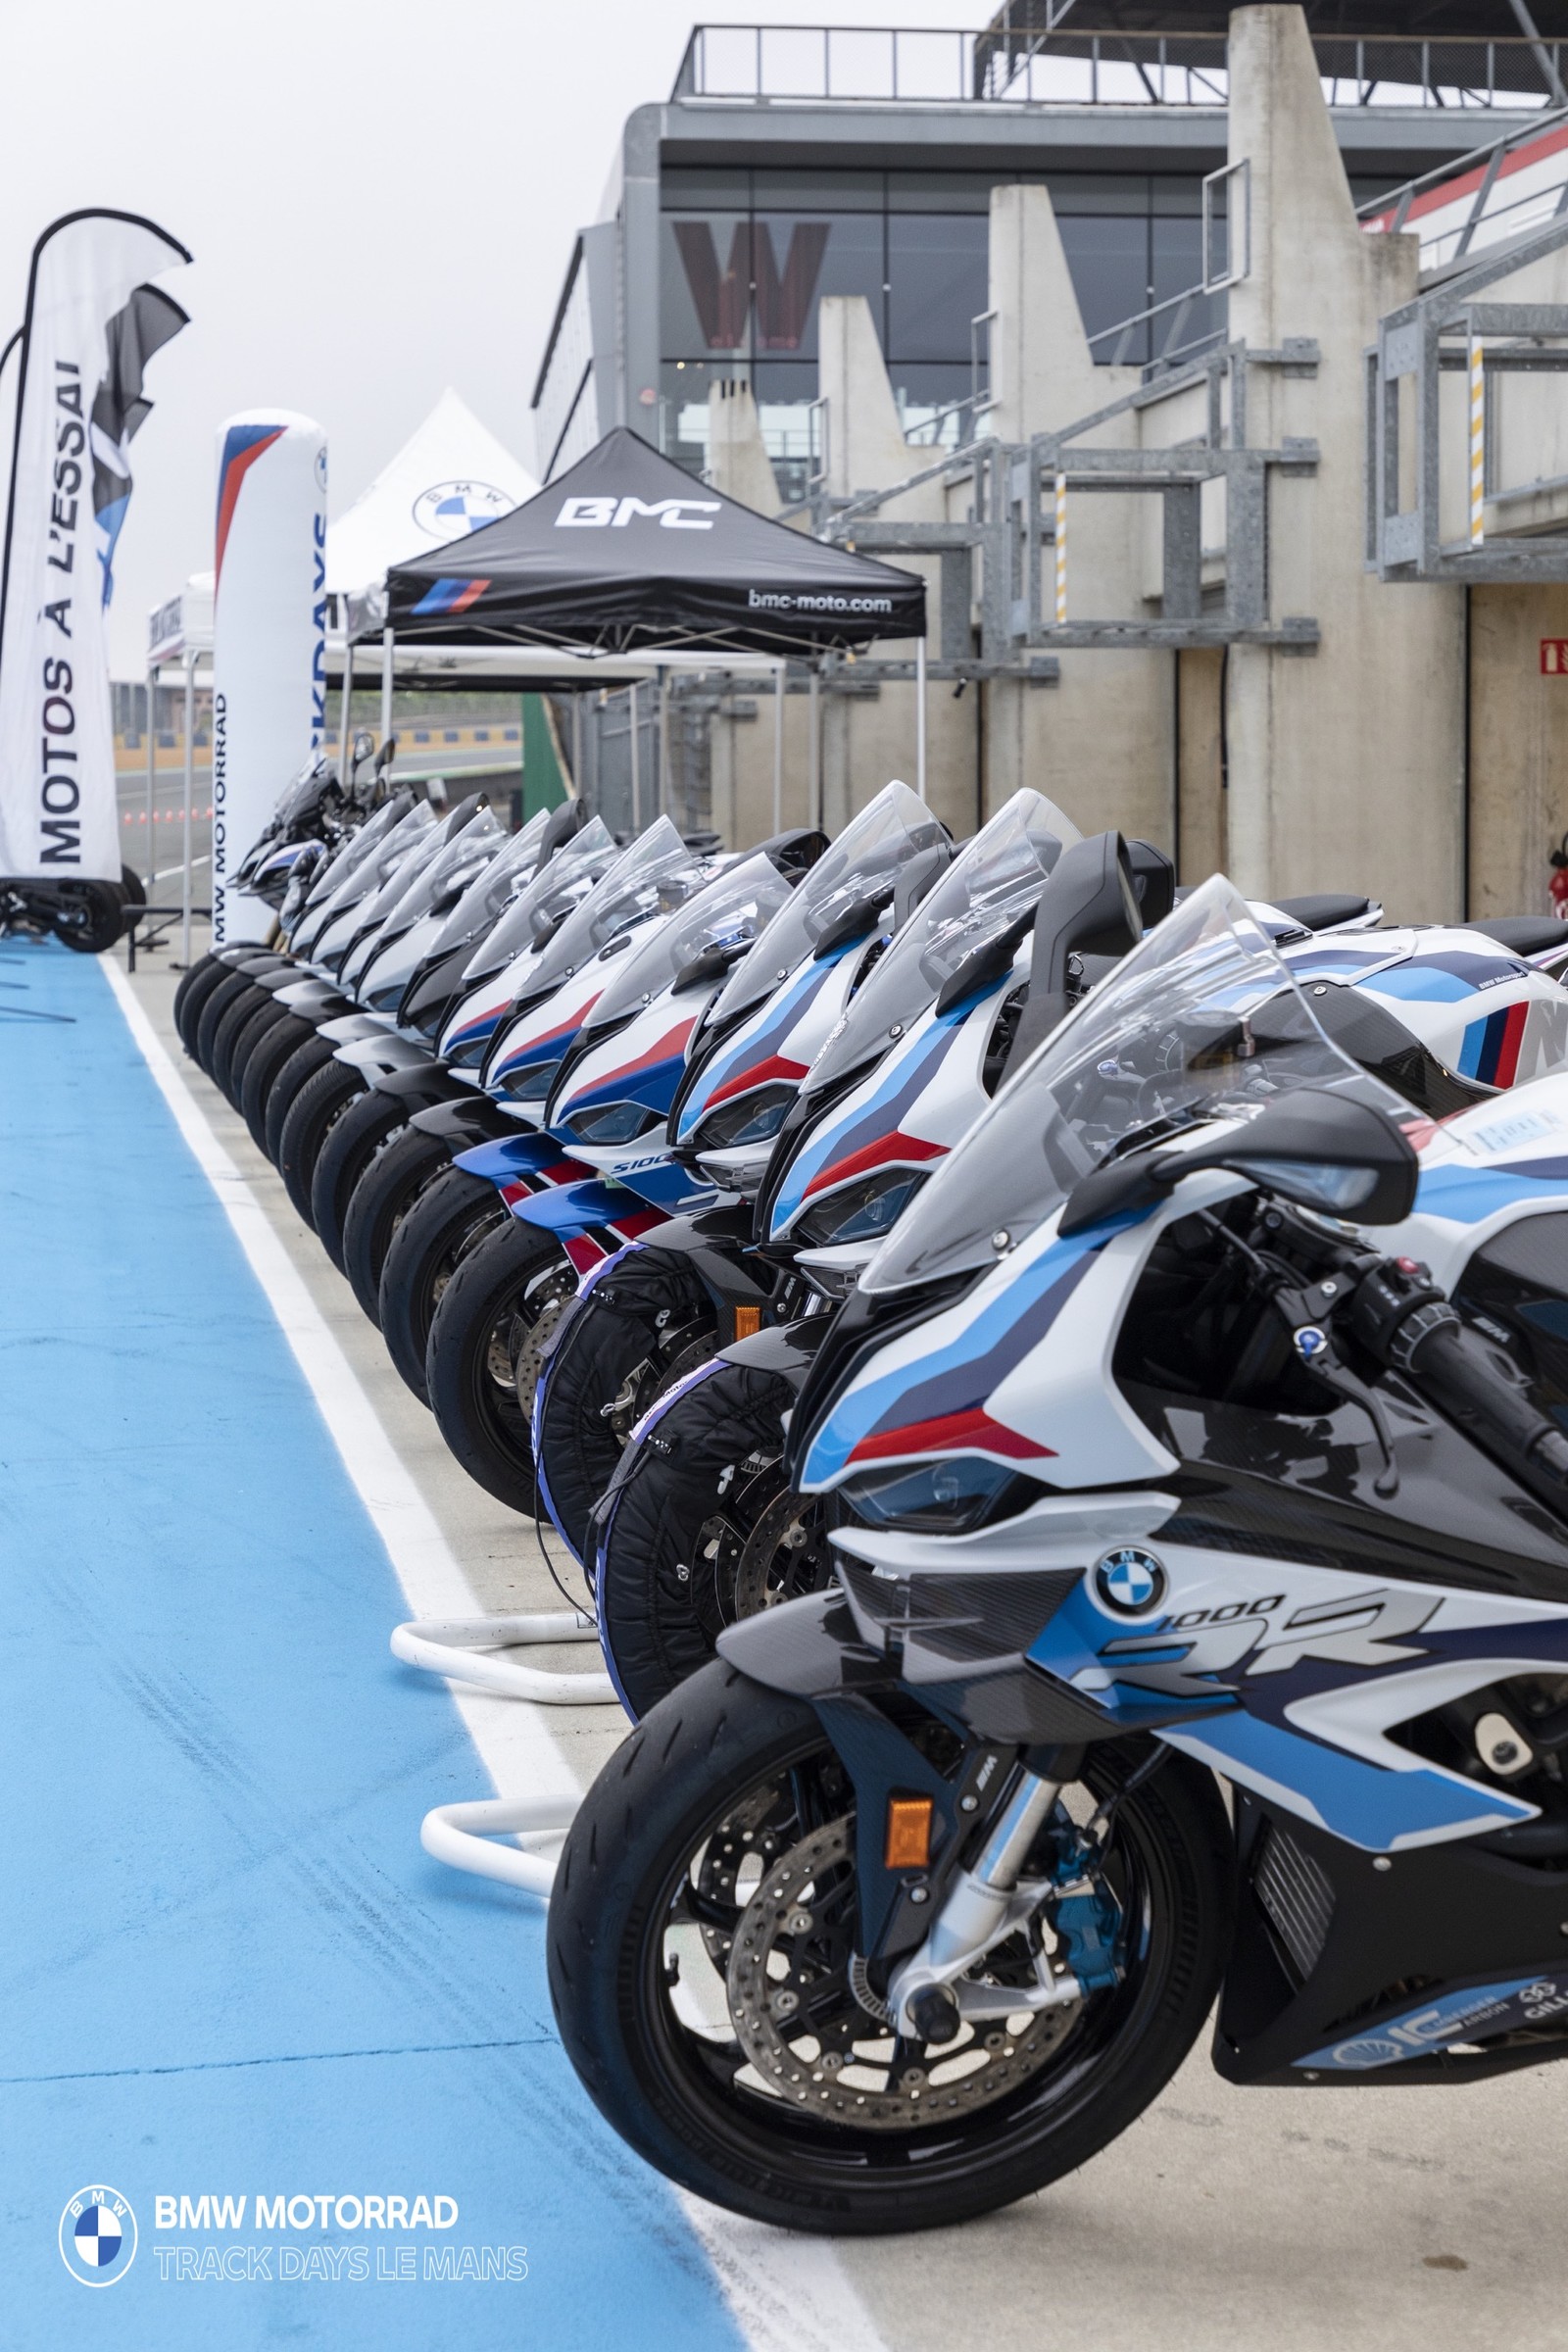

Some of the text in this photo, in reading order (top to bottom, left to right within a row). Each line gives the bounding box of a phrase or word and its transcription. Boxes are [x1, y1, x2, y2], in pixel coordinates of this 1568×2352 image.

[425, 483, 503, 504] BMW
[555, 496, 722, 530] BMC
[36, 359, 85, 864] MOTOS À L'ESSAI
[748, 588, 893, 614] bmc-moto.com
[214, 693, 226, 943] MW MOTORRAD
[1478, 978, 1496, 990] BMW
[1100, 1550, 1157, 1574] BMW
[1156, 1594, 1286, 1632] 1000
[1524, 1990, 1568, 2020] GILL
